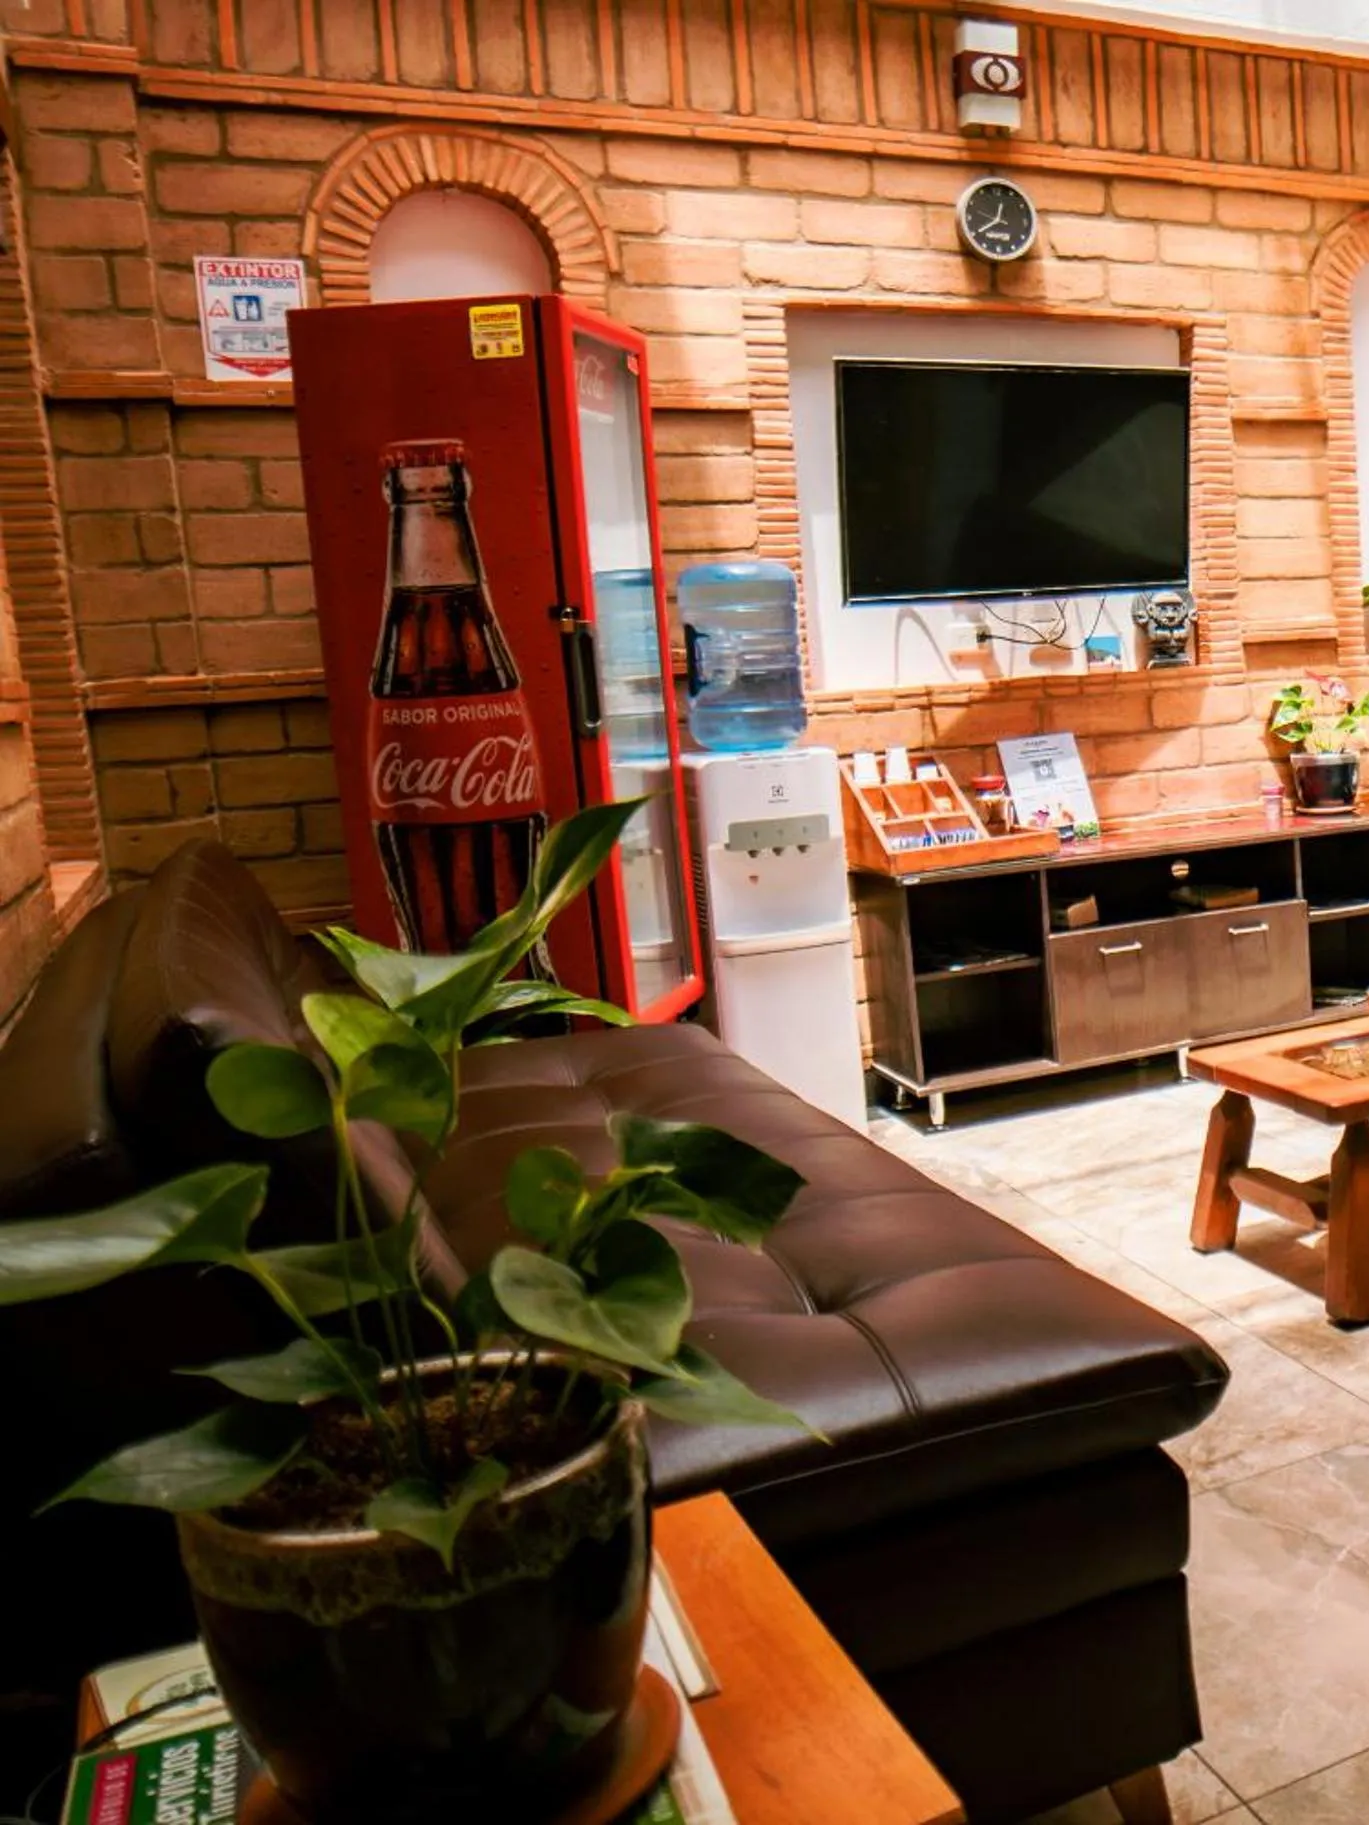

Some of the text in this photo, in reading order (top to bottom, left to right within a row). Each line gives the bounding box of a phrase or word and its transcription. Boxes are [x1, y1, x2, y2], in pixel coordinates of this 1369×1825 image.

[202, 262, 297, 279] EXTINTOR
[382, 702, 523, 725] SABOR ORIGINAL
